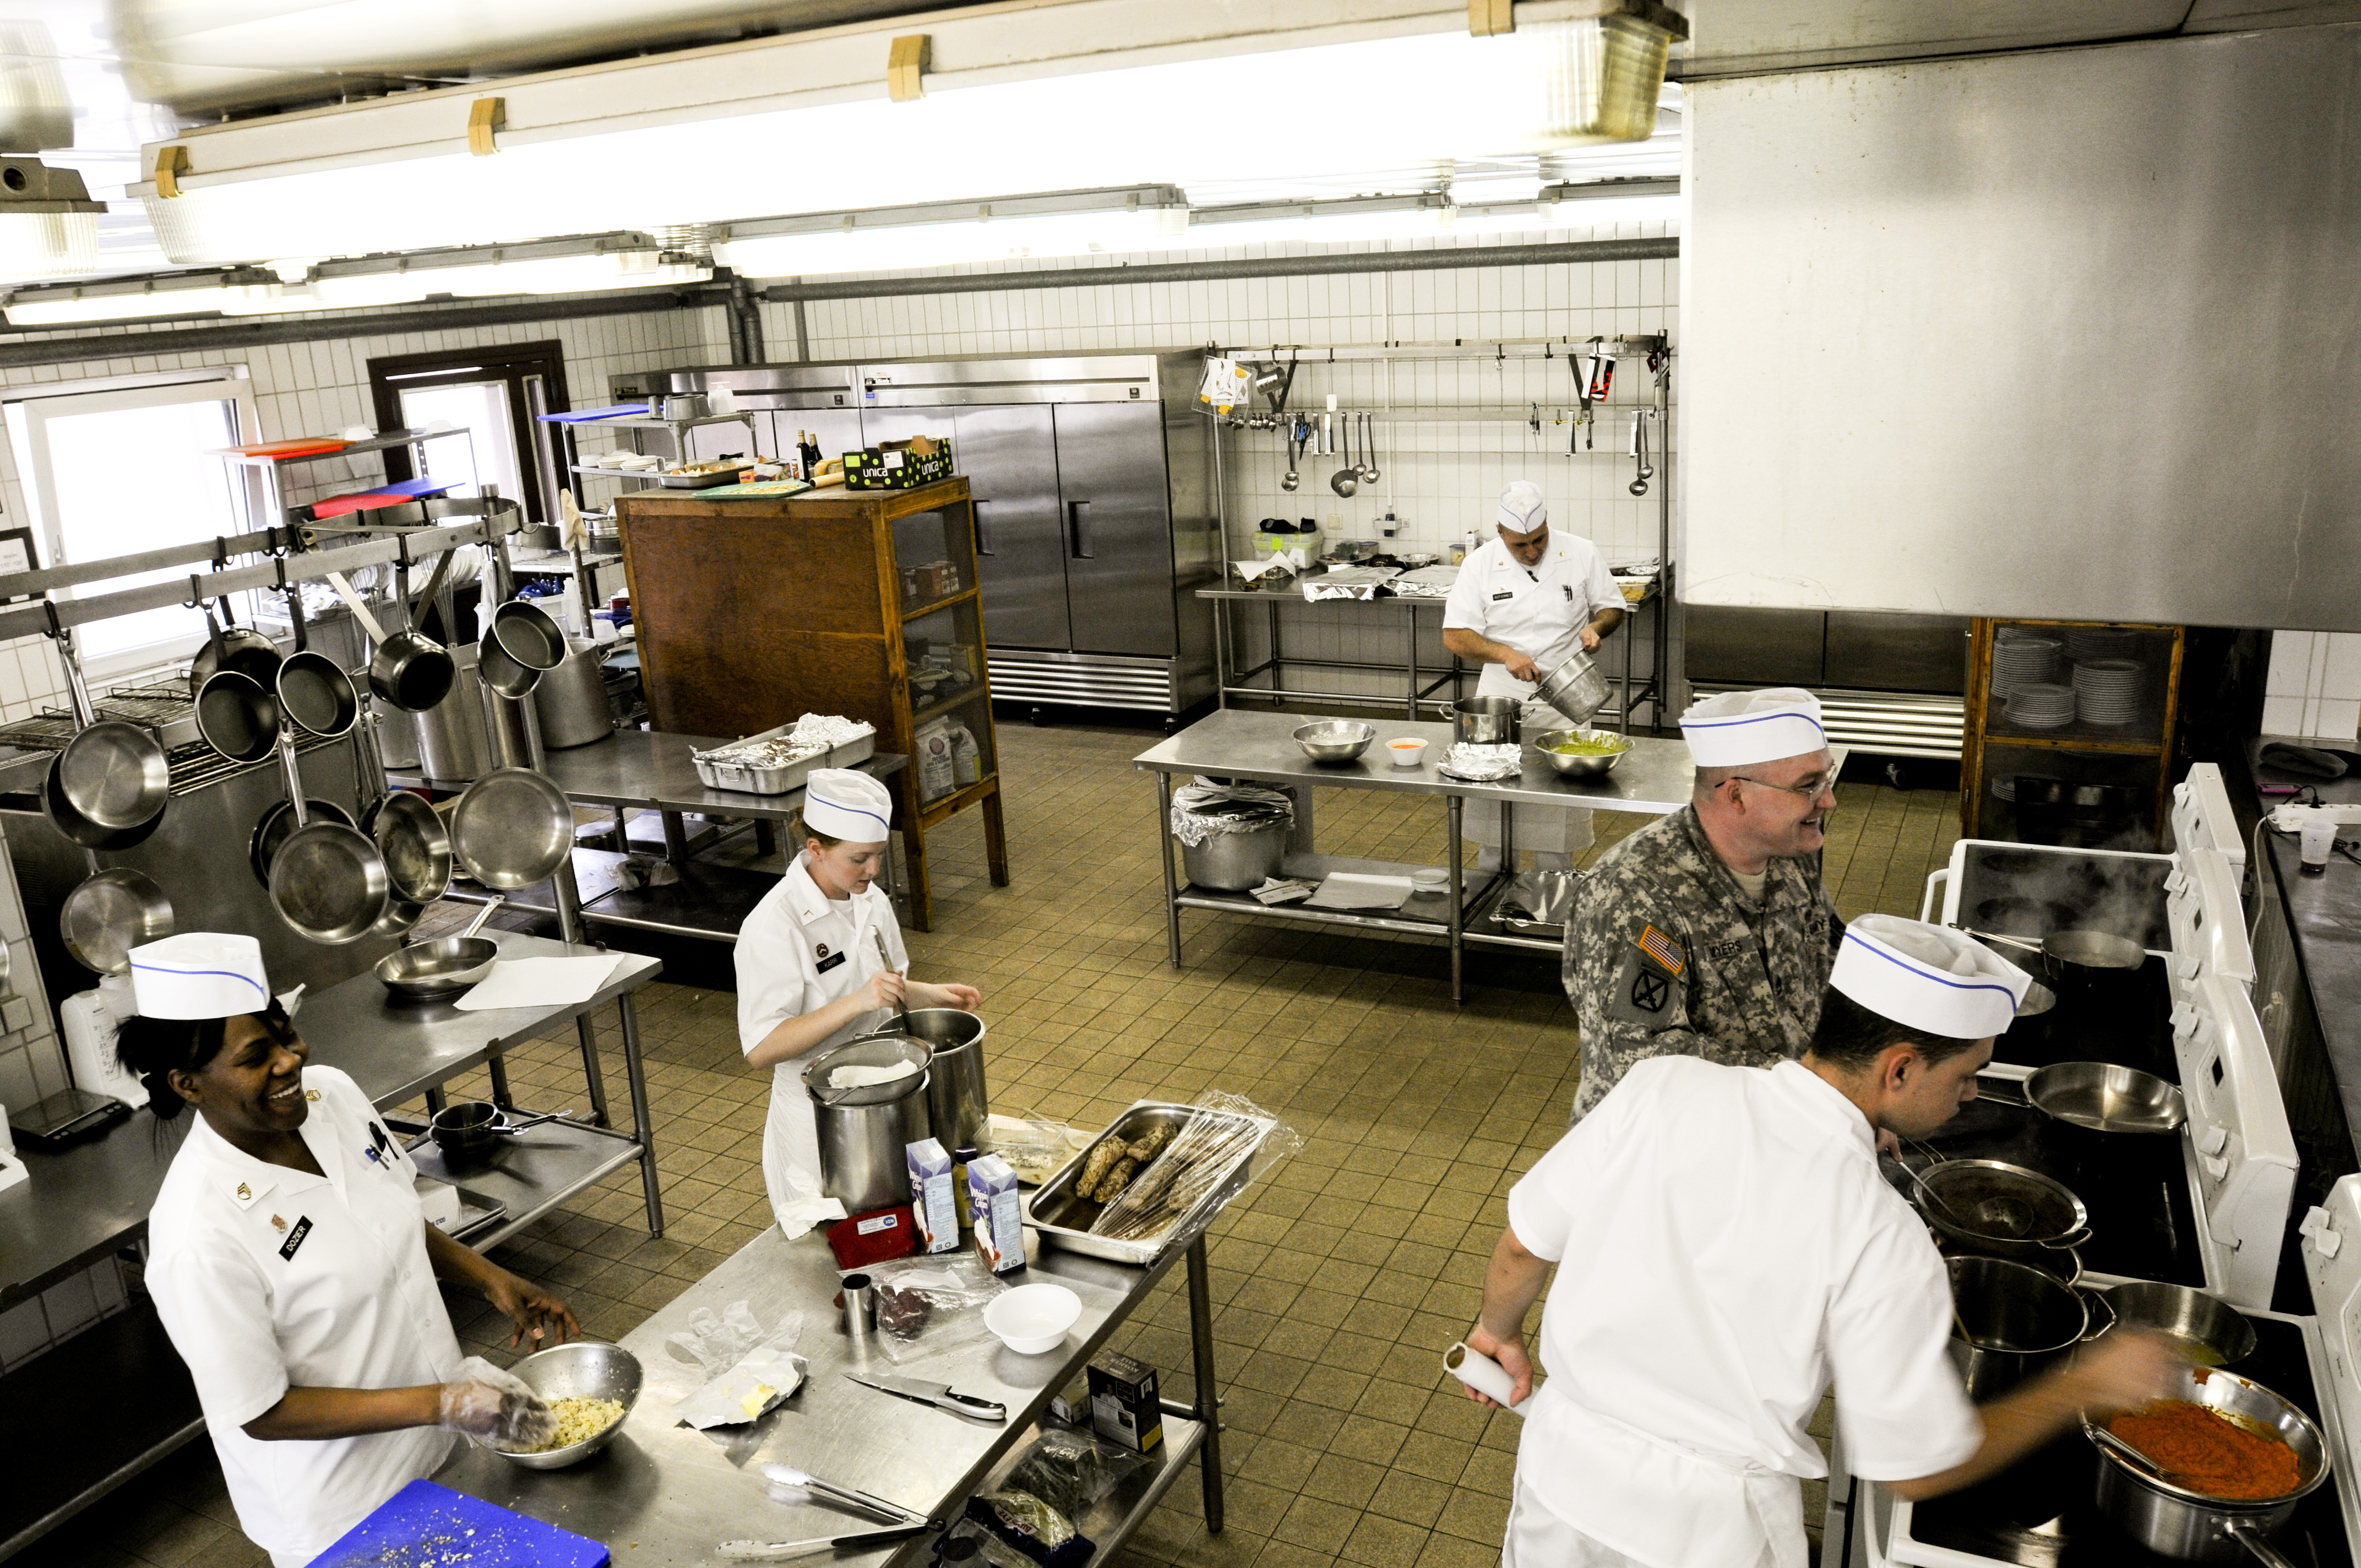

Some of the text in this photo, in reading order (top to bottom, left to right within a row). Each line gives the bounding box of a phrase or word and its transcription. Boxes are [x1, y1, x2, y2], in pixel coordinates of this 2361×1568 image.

[863, 467, 888, 477] unica
[921, 461, 939, 475] unica
[824, 957, 837, 968] KARR
[286, 1226, 306, 1251] DOZIER
